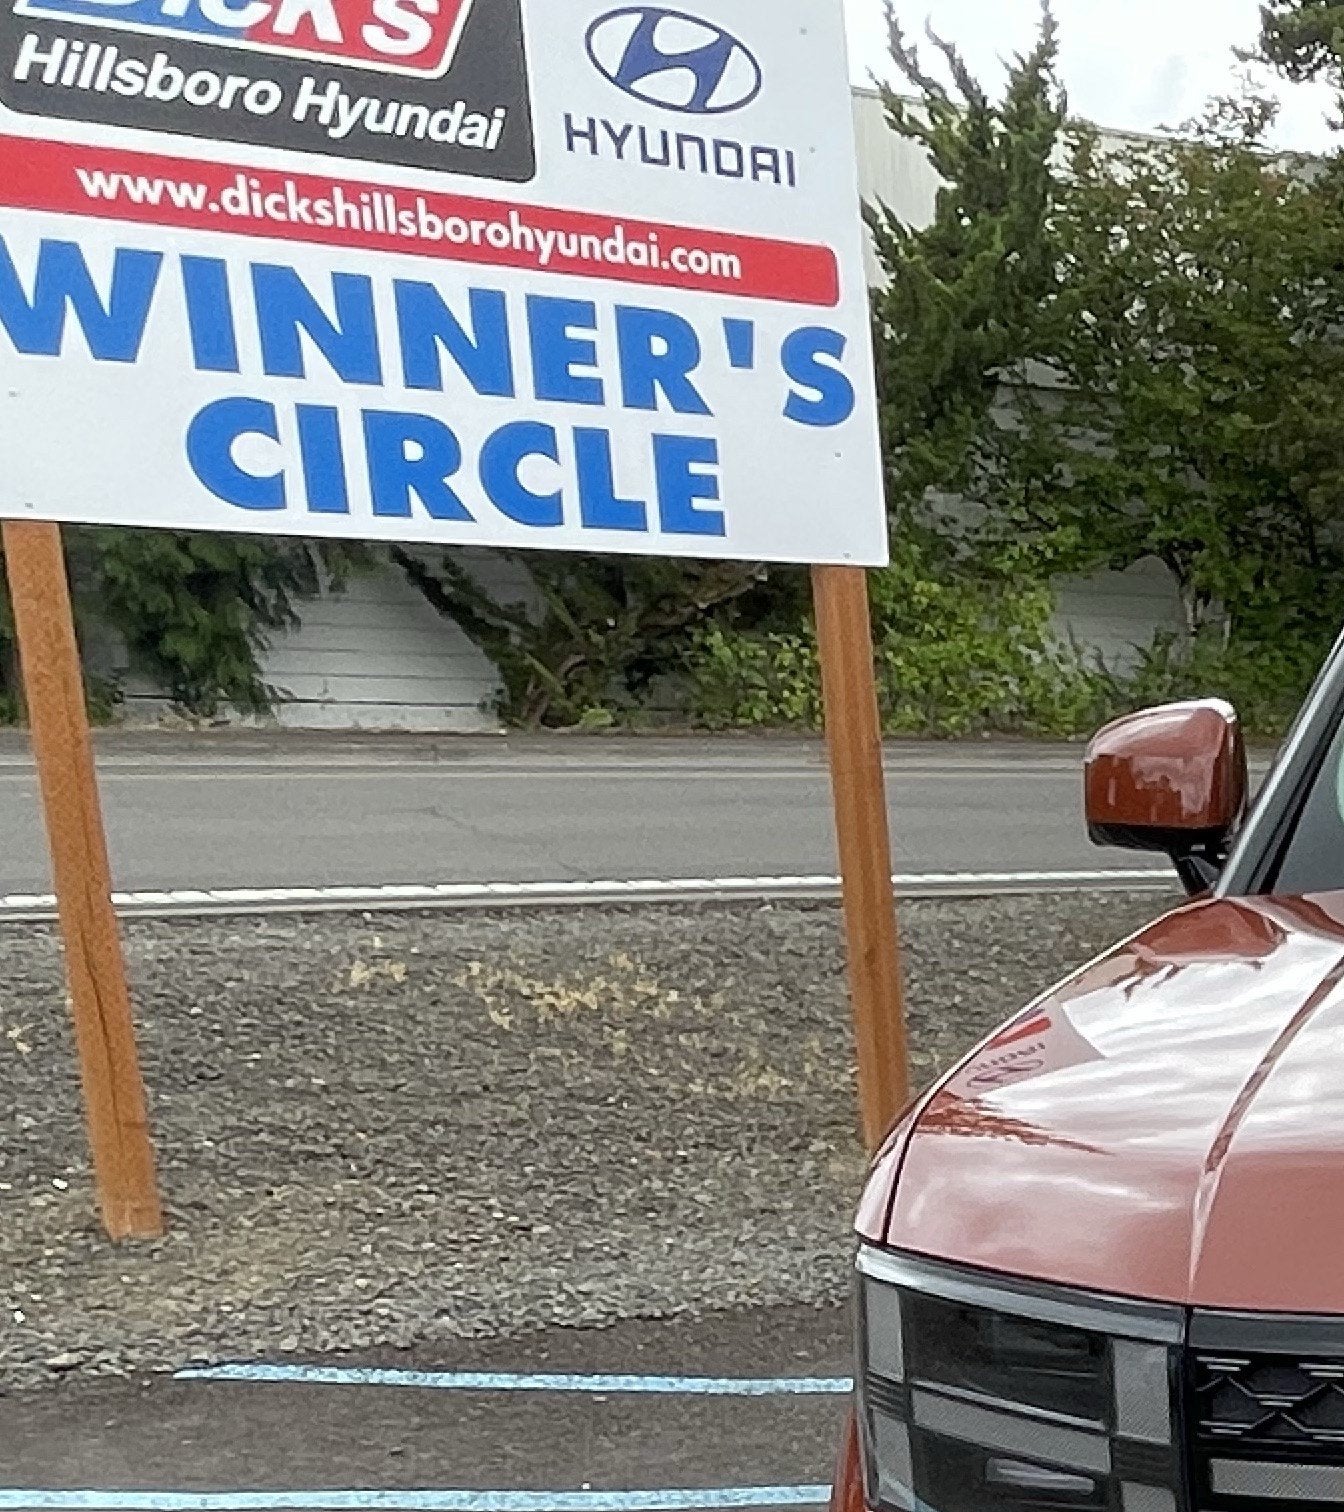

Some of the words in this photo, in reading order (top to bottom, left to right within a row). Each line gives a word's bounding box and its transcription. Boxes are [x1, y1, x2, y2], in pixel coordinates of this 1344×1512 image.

[13, 33, 283, 116] Hillsboro
[292, 76, 506, 151] Hyundai
[565, 115, 795, 187] HYUNDAI
[75, 167, 742, 281] www.dickshillsborohyundai.com
[0, 237, 857, 427] WINNER'S
[186, 396, 726, 537] CIRCLE
